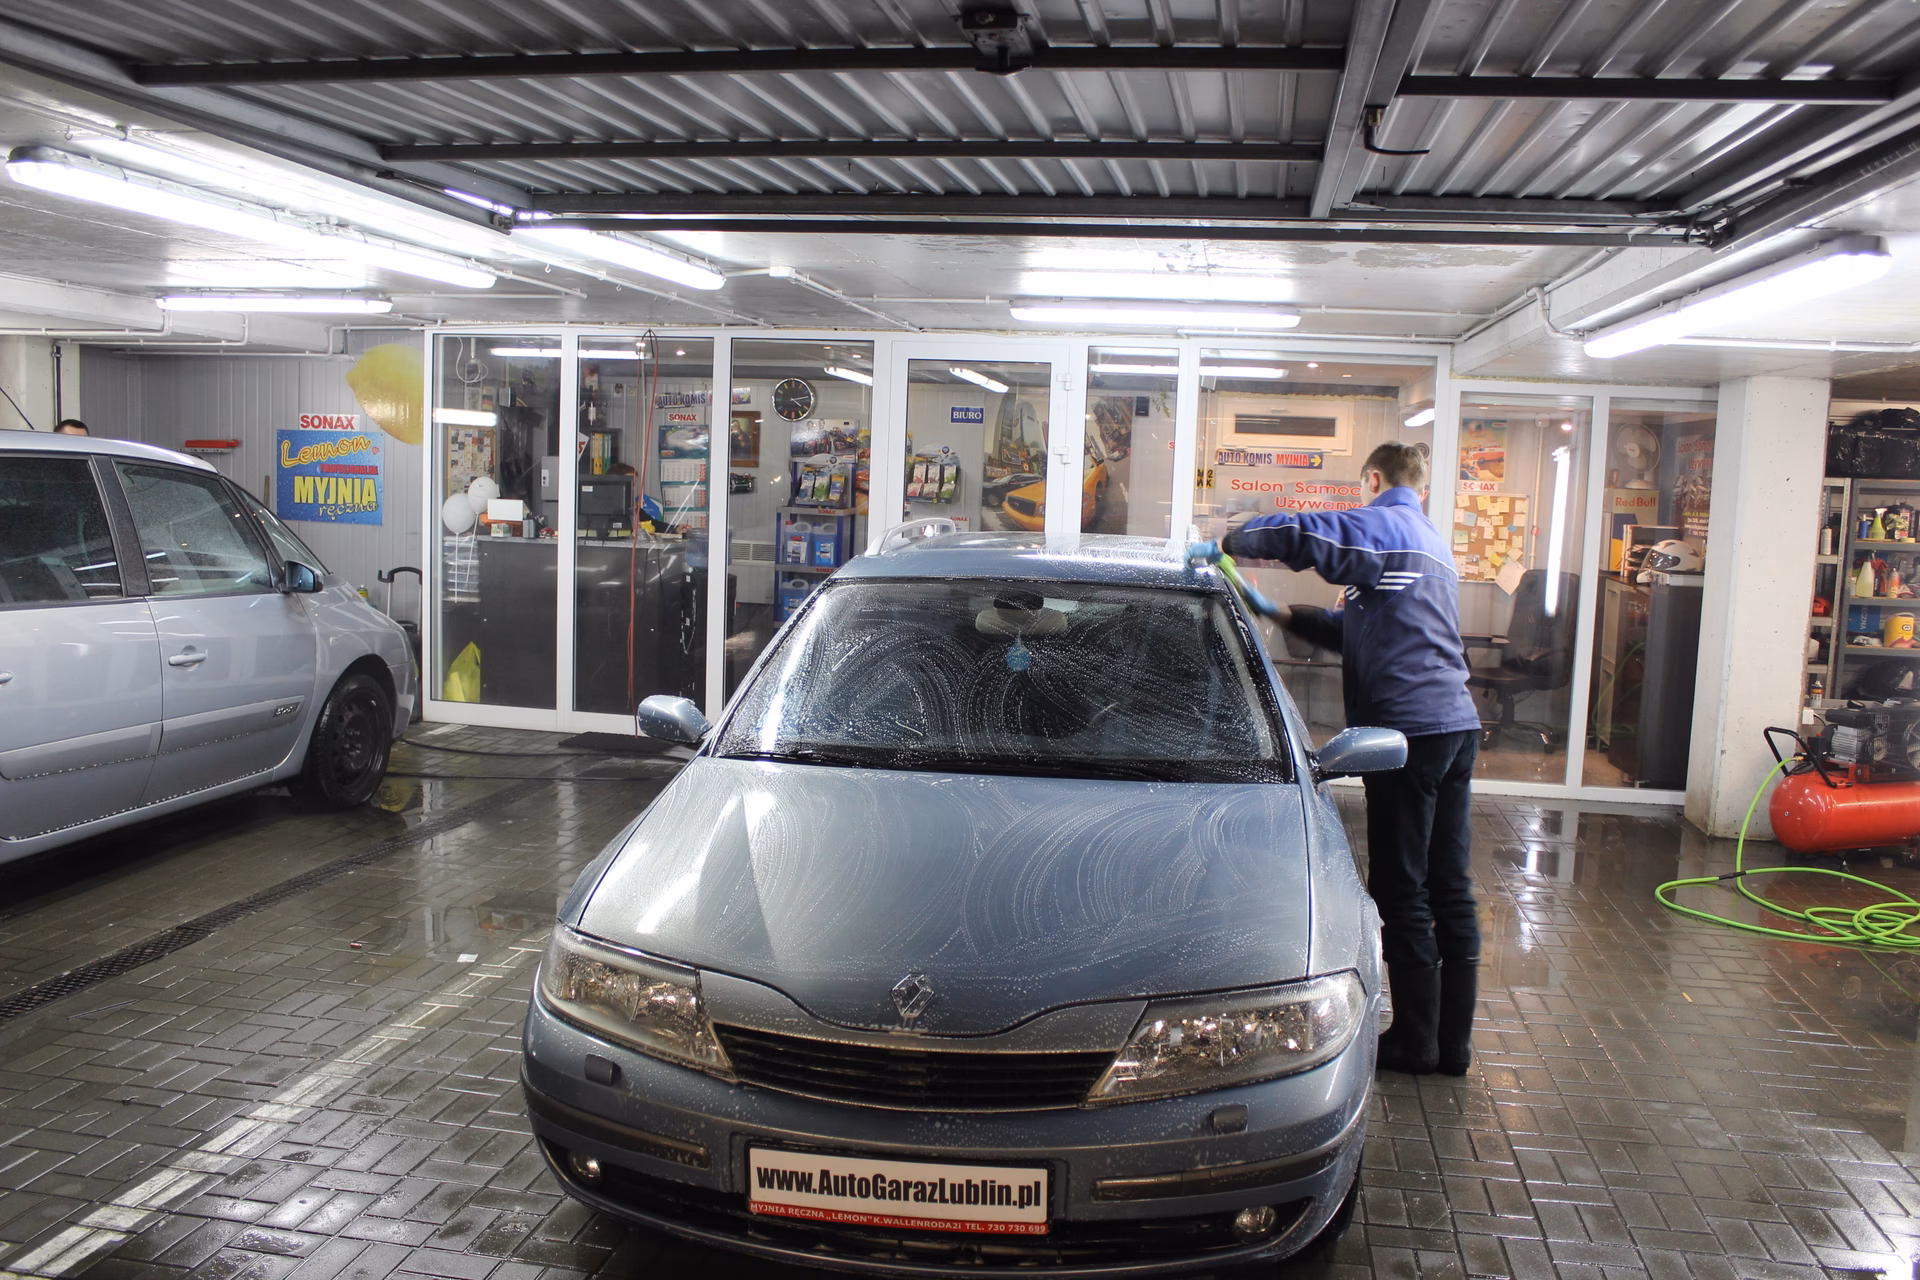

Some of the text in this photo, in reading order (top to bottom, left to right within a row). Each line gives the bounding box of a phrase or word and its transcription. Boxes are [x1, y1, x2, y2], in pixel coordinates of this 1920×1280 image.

[657, 394, 678, 406] AUTO
[680, 393, 706, 405] KOMIS
[300, 415, 355, 430] SONAX
[668, 413, 697, 422] SONAX
[952, 410, 983, 420] BIURO
[281, 436, 371, 468] Lemon
[1218, 451, 1310, 467] AUTO KOMIS MYJNIA
[293, 475, 377, 505] MYJNIA
[1231, 479, 1362, 496] Salon Samoc
[1463, 482, 1495, 491] SONAX
[1615, 497, 1656, 507] Red Bull
[319, 501, 379, 521] ręczna
[756, 1166, 1041, 1210] www.AutoGarazLublin.pl
[750, 1202, 786, 1214] MYJNIA
[788, 1207, 825, 1218] RĘCZNA
[965, 1222, 985, 1231] TEL.
[987, 1223, 1005, 1231] 730
[1008, 1224, 1026, 1232] 730
[1028, 1225, 1046, 1233] 699
